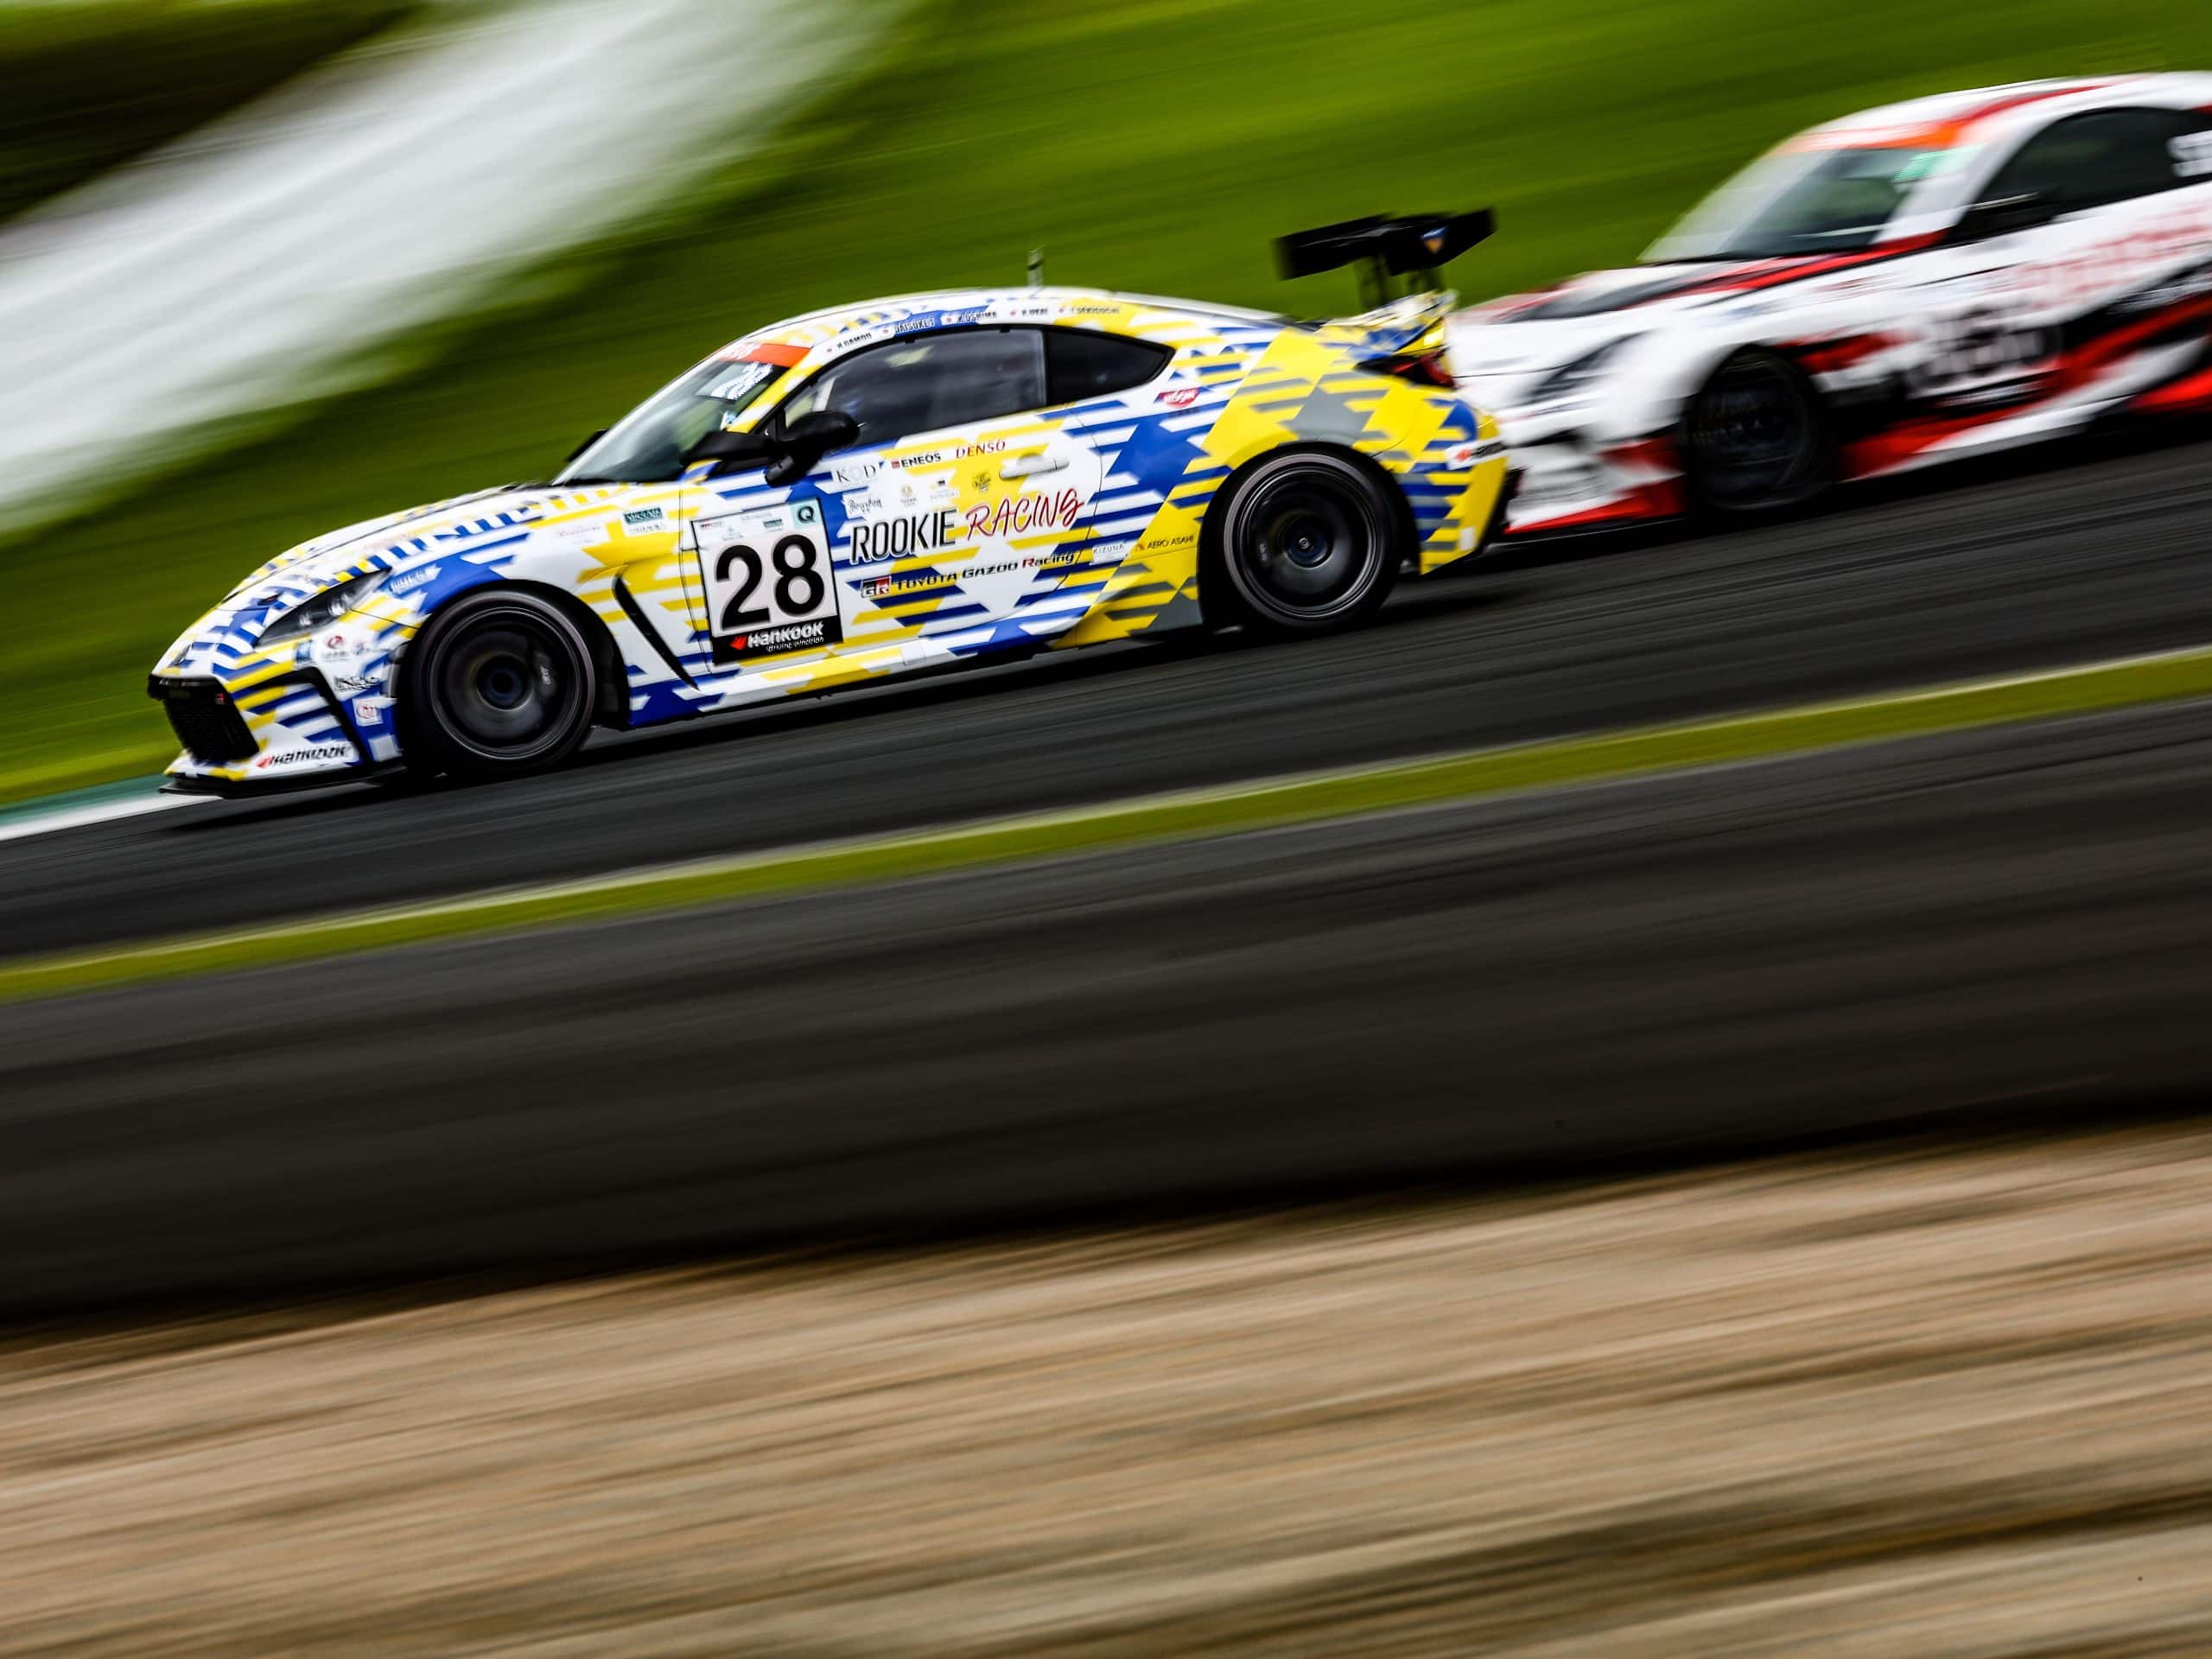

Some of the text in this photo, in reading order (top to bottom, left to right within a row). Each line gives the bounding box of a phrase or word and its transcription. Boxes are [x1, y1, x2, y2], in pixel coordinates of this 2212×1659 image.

[901, 453, 941, 467] ENEOS
[956, 441, 1006, 459] DENSO
[851, 487, 1085, 563] ROOKIE RACING
[1147, 535, 1194, 550] AERO ASAHI
[716, 534, 824, 631] 28
[862, 552, 1075, 597] GR TOYOTA GAZOO Racing
